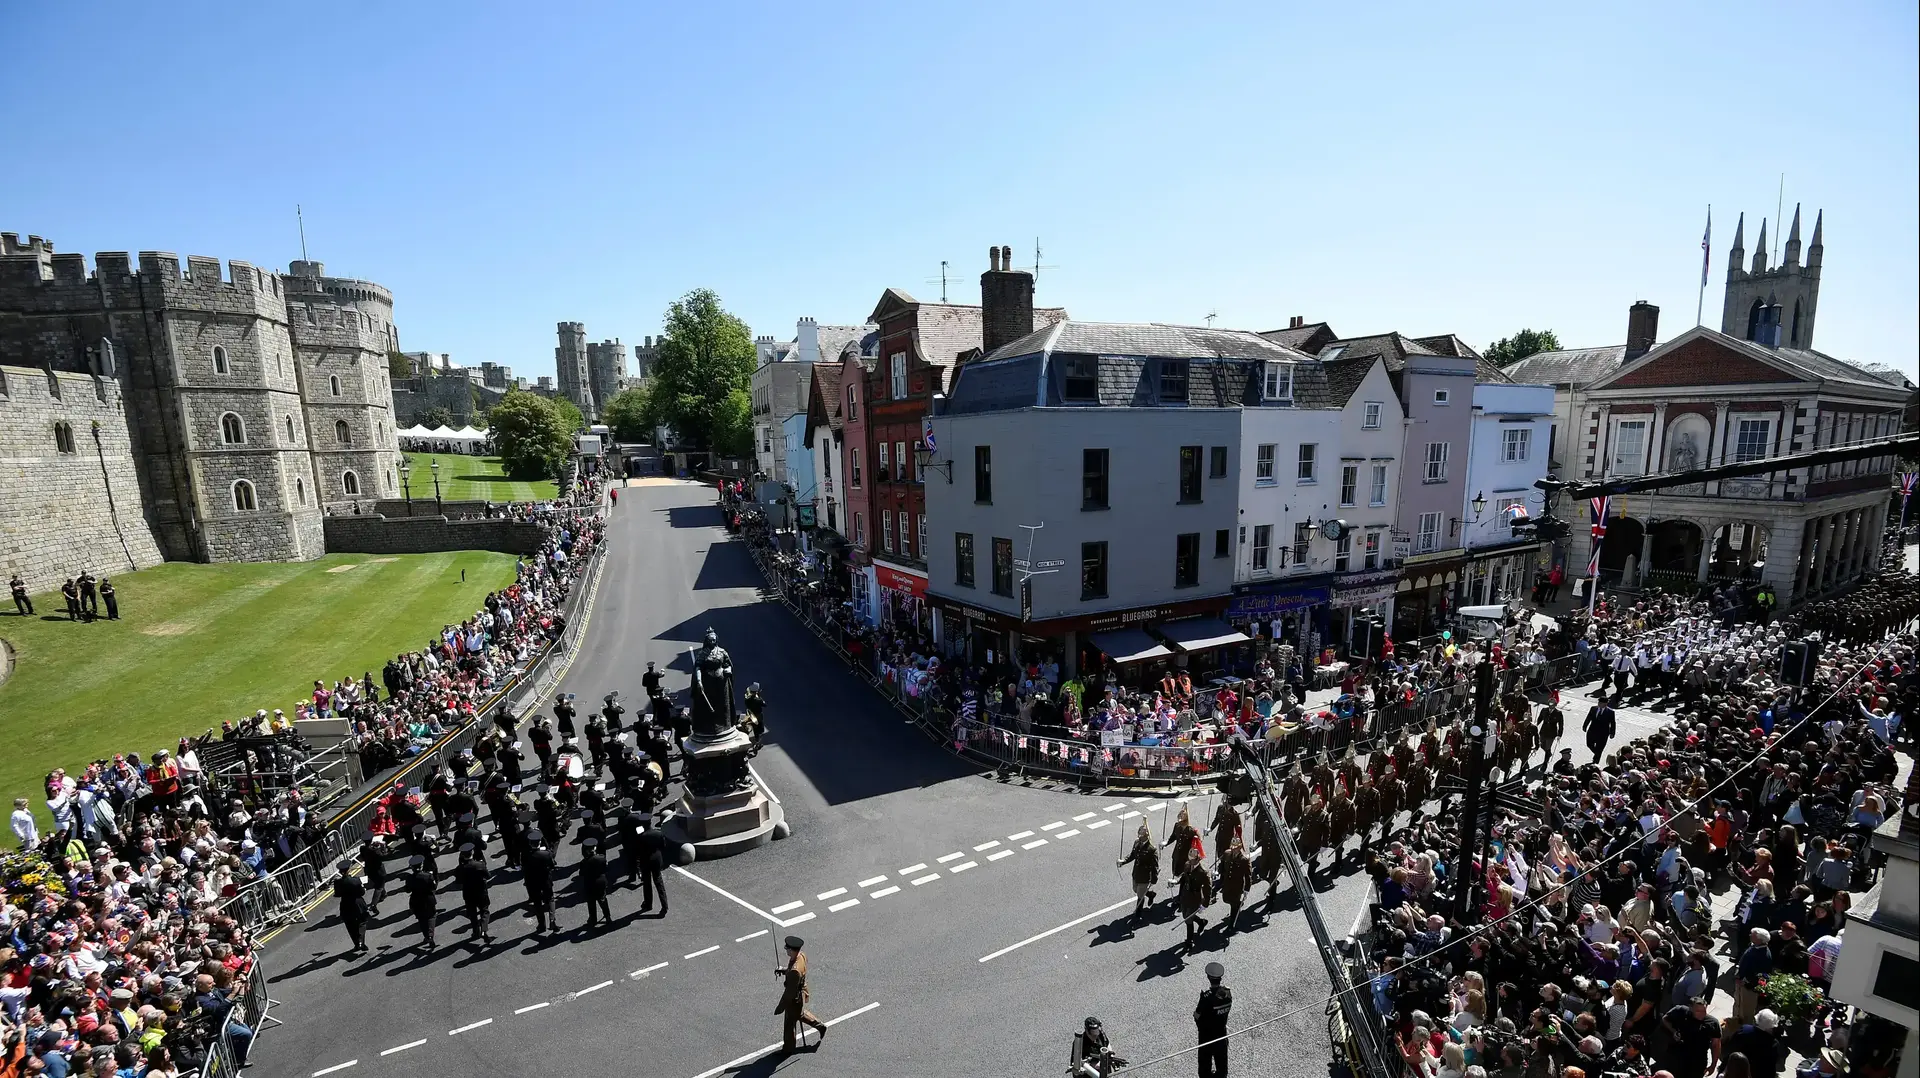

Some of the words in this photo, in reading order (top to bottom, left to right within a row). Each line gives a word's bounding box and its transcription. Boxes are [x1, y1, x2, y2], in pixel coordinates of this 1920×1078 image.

[1247, 596, 1270, 609] Little
[1273, 594, 1303, 611] Present
[962, 606, 986, 622] BLUEGRASS
[1121, 609, 1158, 623] BLUEGRASS
